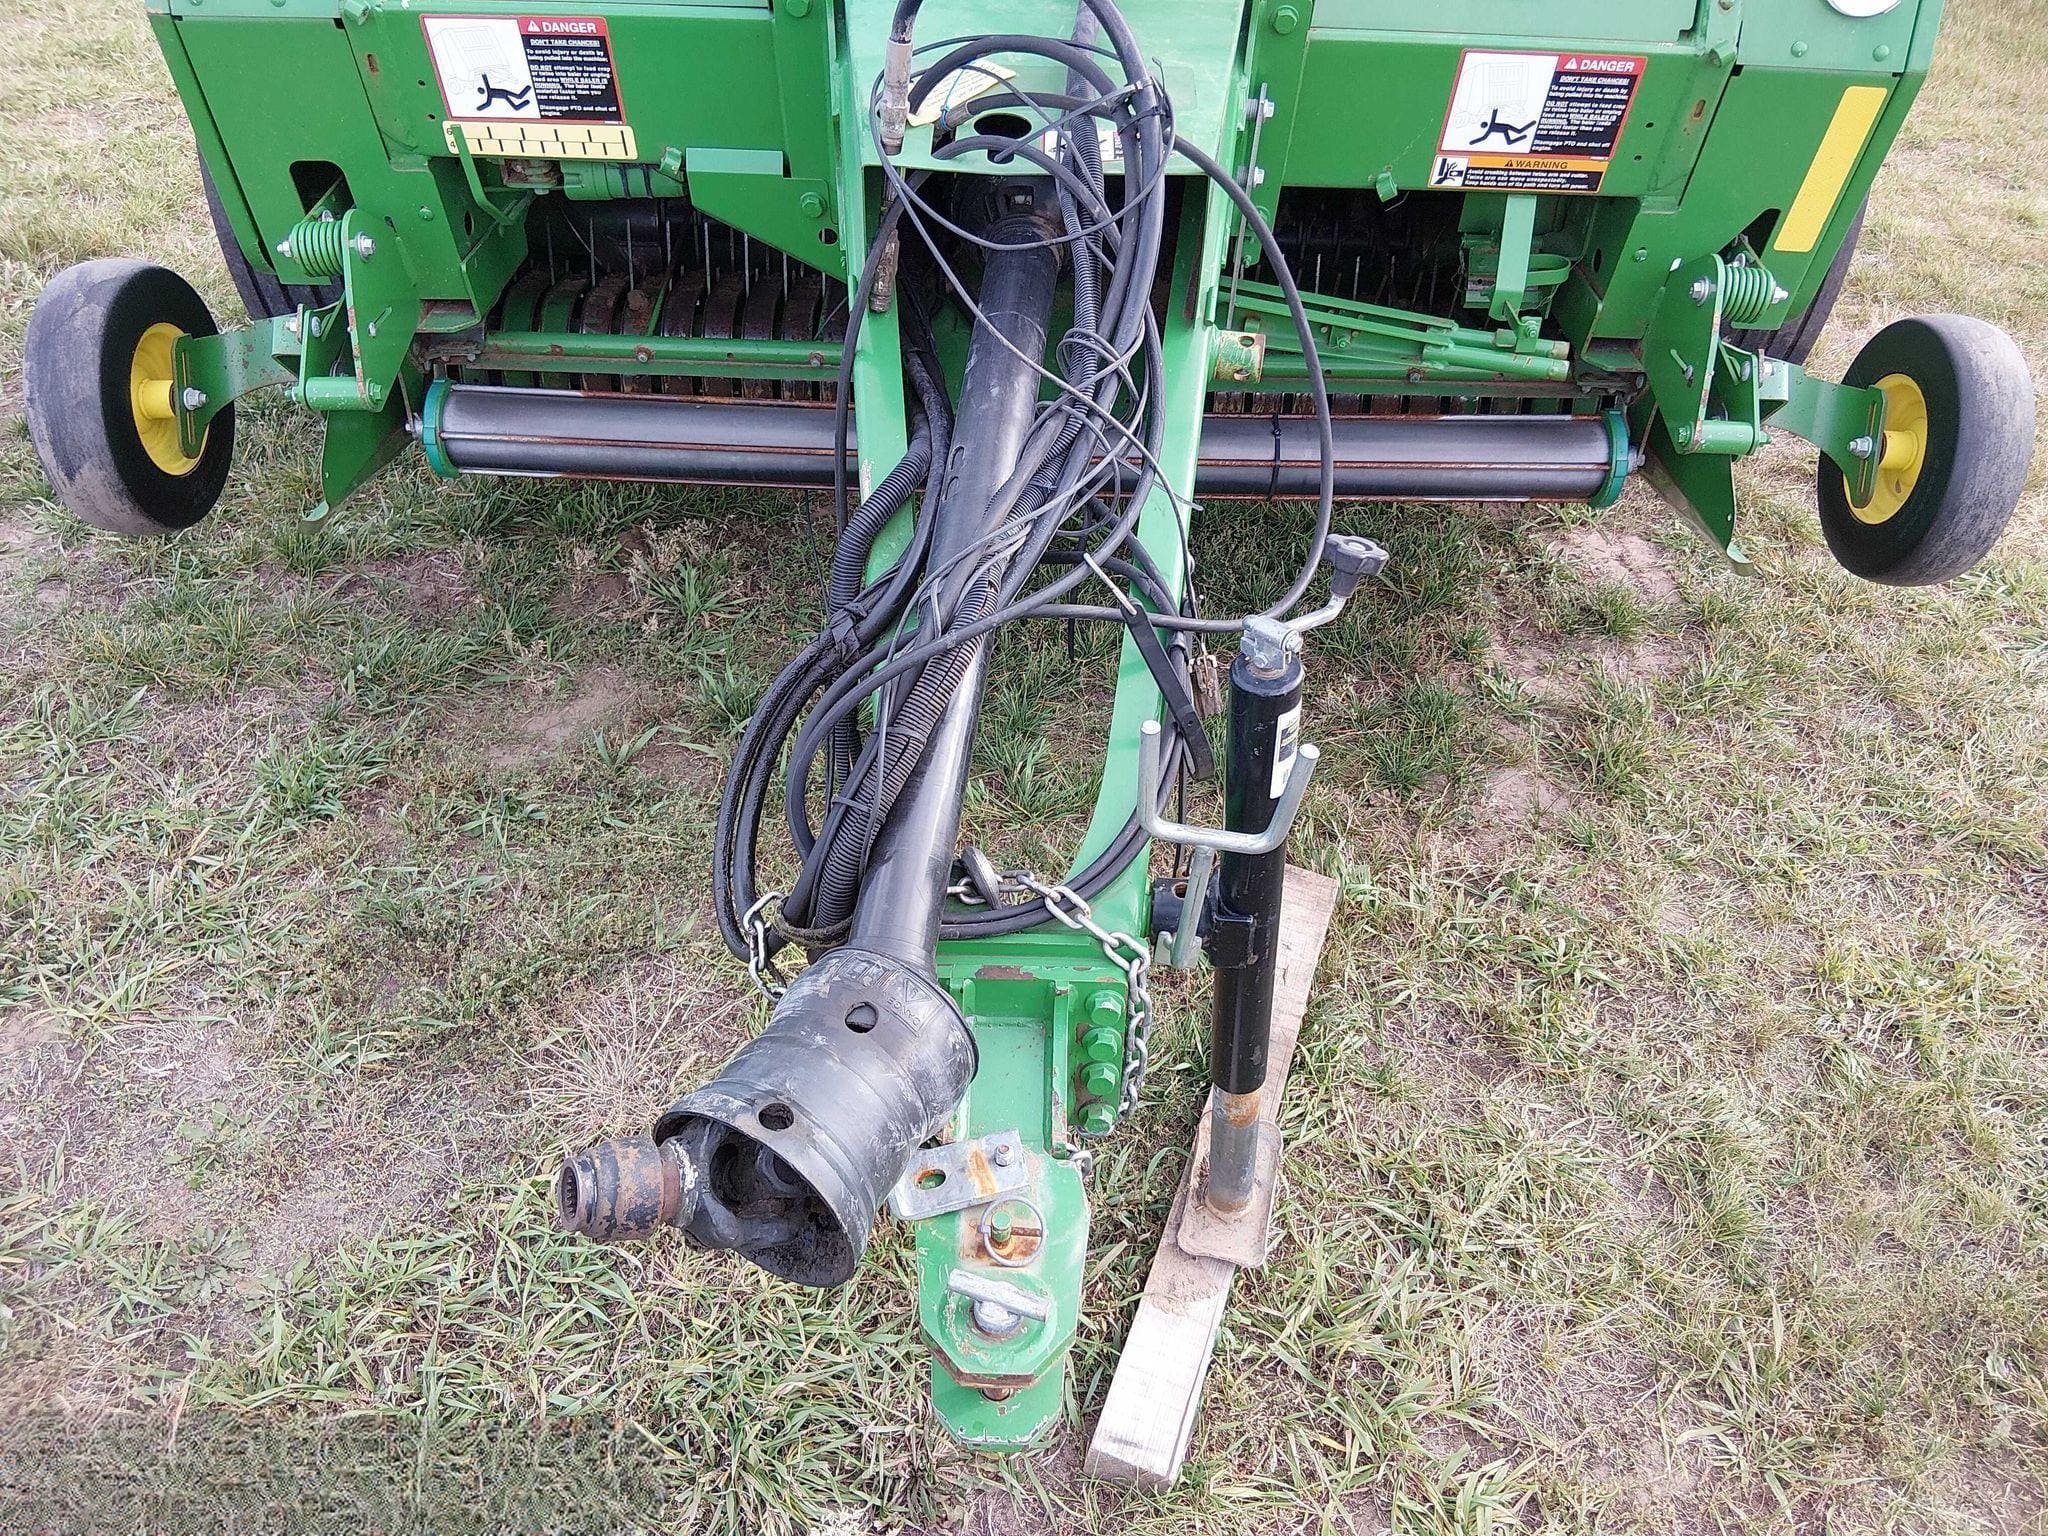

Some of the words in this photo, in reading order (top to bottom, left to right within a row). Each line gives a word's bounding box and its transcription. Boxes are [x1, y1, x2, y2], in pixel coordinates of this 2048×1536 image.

[542, 22, 597, 33] DANGER
[1580, 60, 1635, 72] DANGER
[1516, 160, 1568, 169] WARNING
